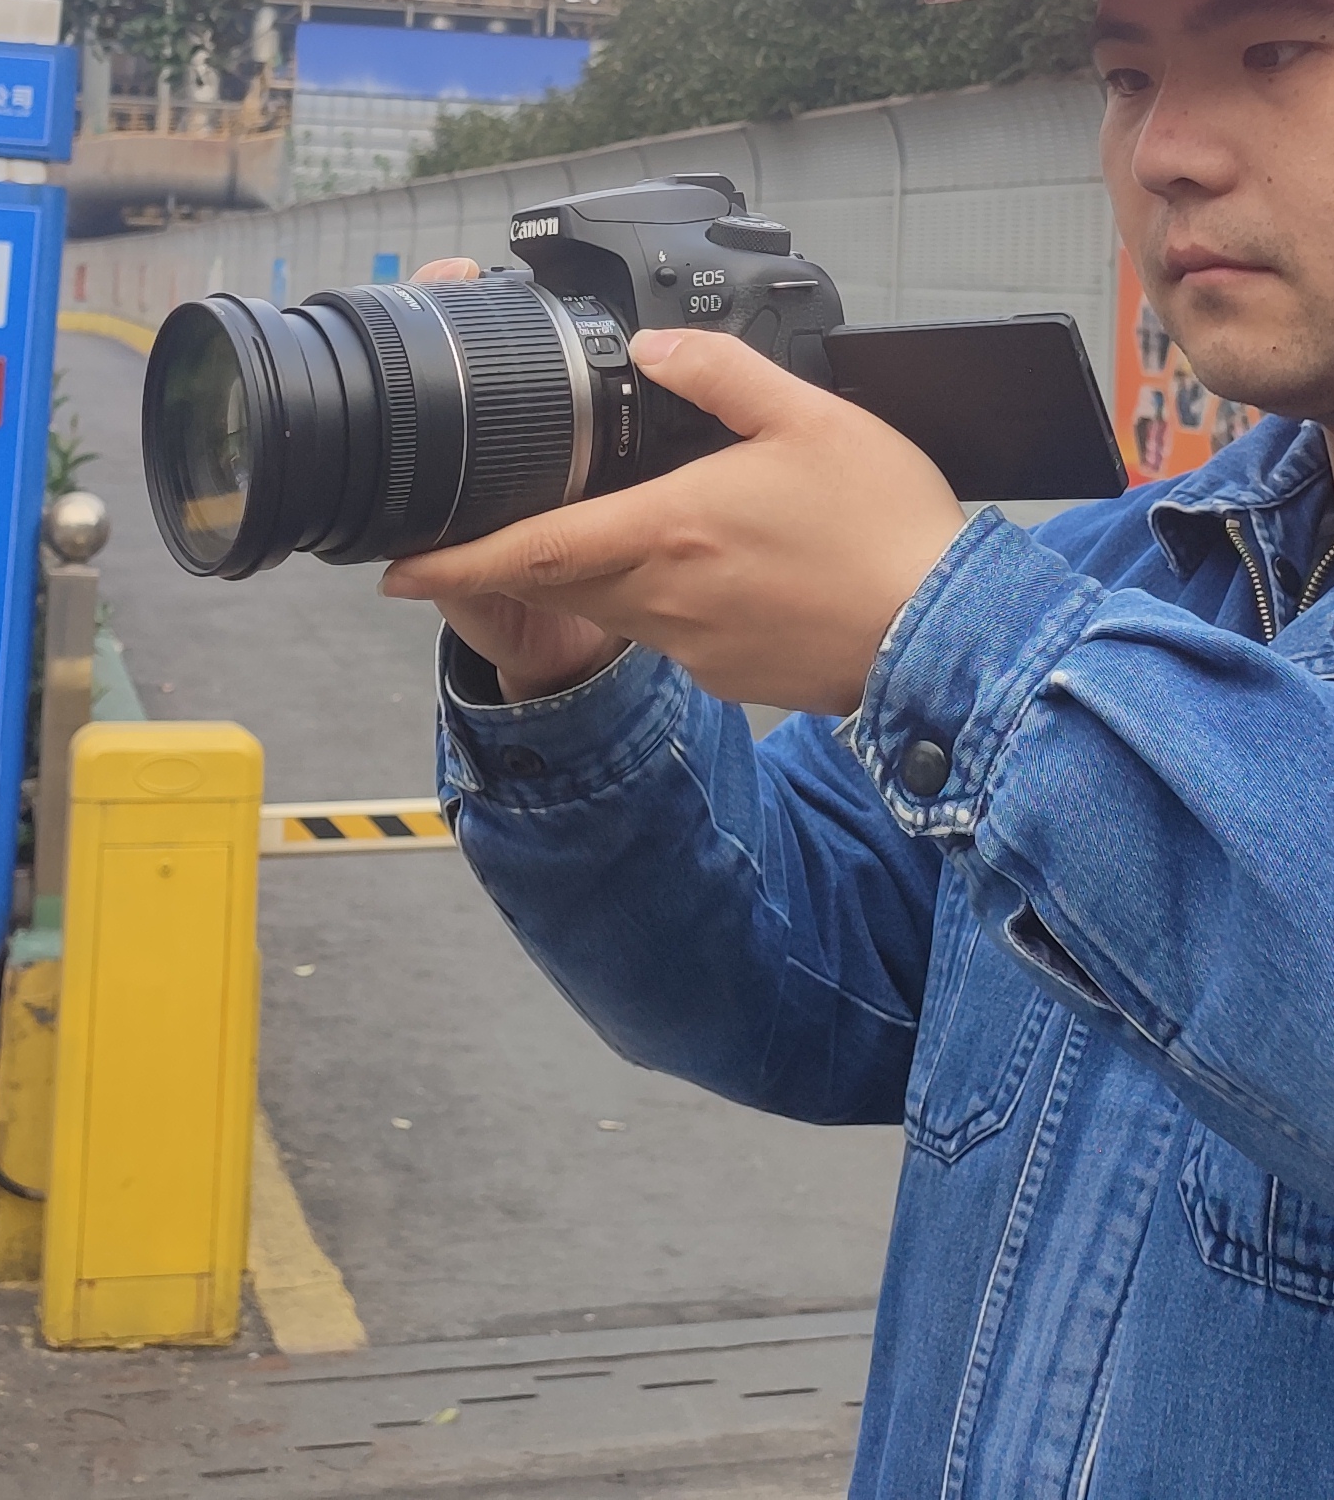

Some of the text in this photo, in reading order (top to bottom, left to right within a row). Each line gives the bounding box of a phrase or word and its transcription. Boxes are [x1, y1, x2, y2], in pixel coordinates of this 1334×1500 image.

[509, 216, 559, 241] Canon
[692, 269, 725, 287] EOS
[688, 295, 723, 313] 90D
[617, 404, 630, 457] Canon
